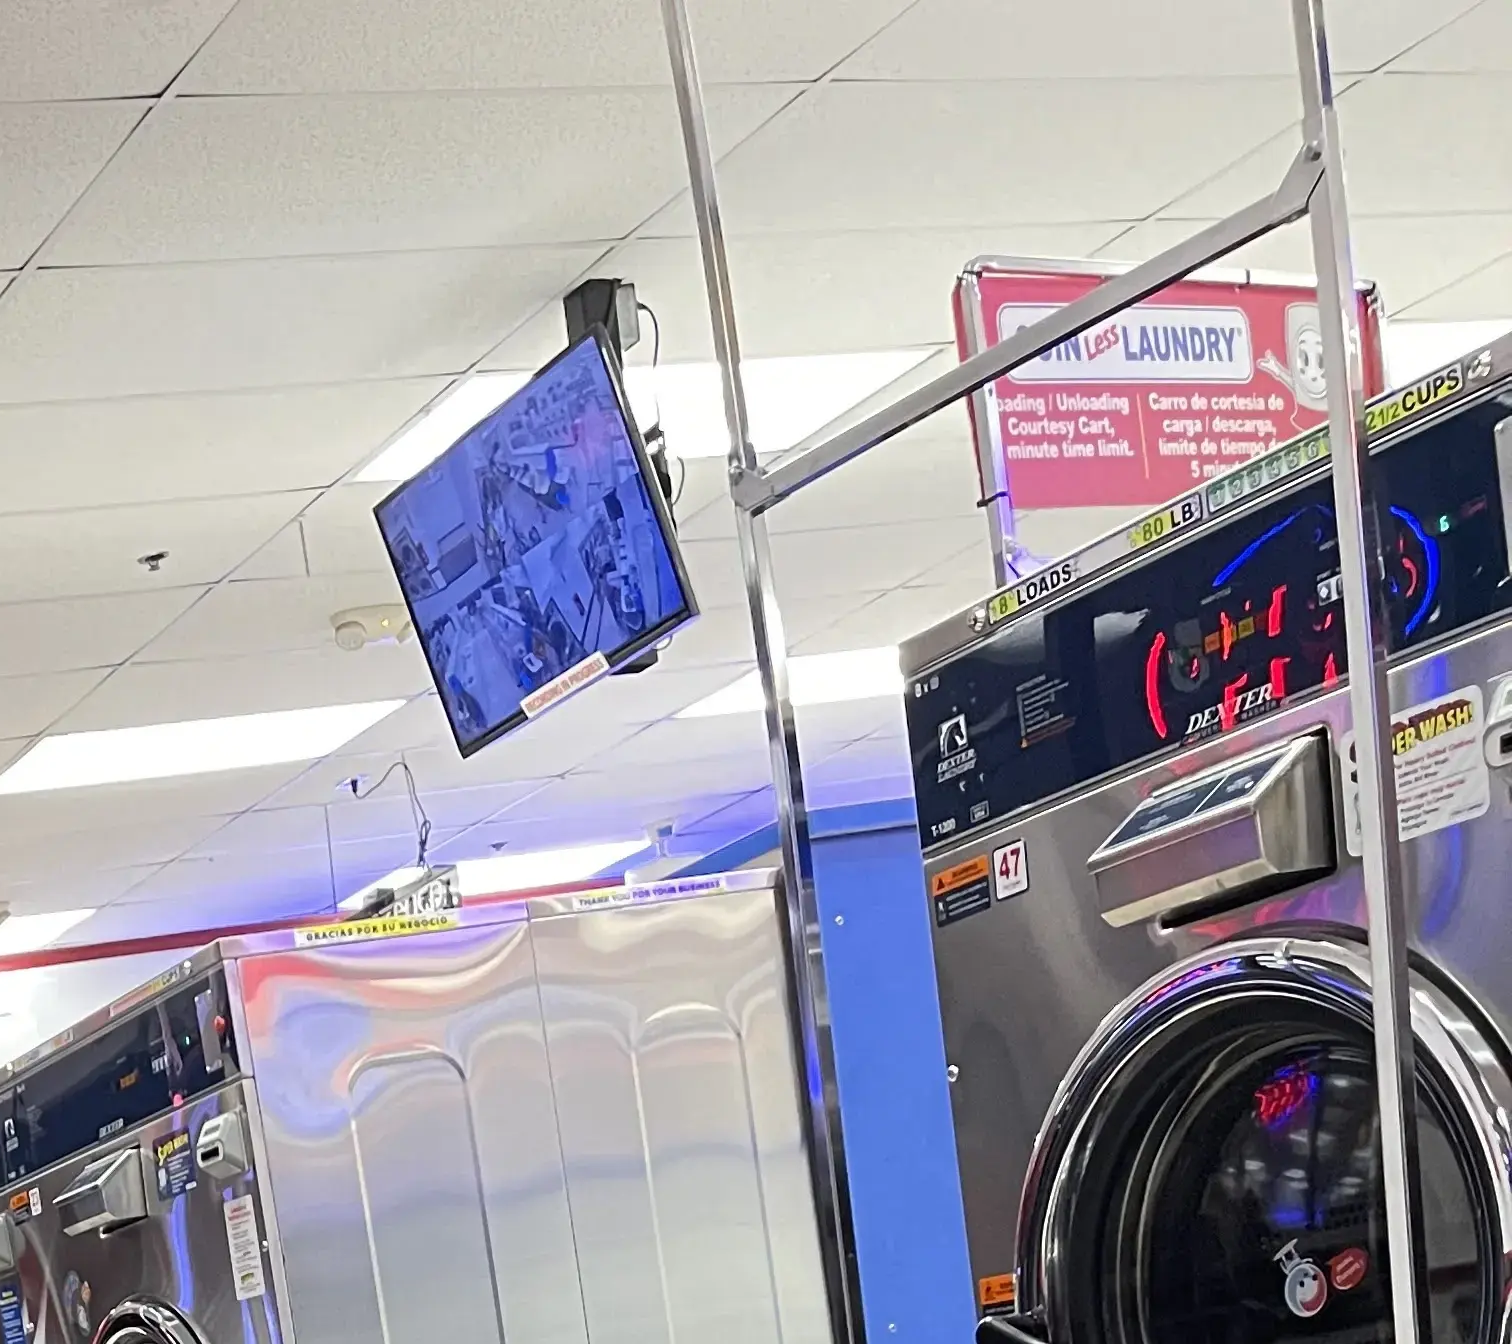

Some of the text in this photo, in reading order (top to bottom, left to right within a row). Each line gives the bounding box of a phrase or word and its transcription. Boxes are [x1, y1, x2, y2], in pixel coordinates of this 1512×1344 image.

[1121, 325, 1236, 362] LAUNDRY
[1148, 392, 1188, 411] Carro
[1191, 393, 1208, 410] de
[1267, 393, 1284, 411] de
[1401, 368, 1460, 413] CUPS
[998, 394, 1046, 415] oading
[1056, 393, 1130, 415] Unloading
[1007, 416, 1116, 438] Courtesy Cart,
[1163, 418, 1202, 436] carga
[1212, 416, 1278, 435] descarga,
[1007, 439, 1136, 459] minute time limit.
[1200, 439, 1218, 455] de
[1191, 461, 1200, 478] 5
[1016, 563, 1072, 607] LOADS
[1142, 517, 1164, 542] 80
[1170, 502, 1195, 529] LB
[1419, 701, 1475, 742] WASH!
[999, 847, 1021, 880] 47
[306, 927, 353, 942] GRACIAS
[399, 915, 448, 930] NEGOCIO
